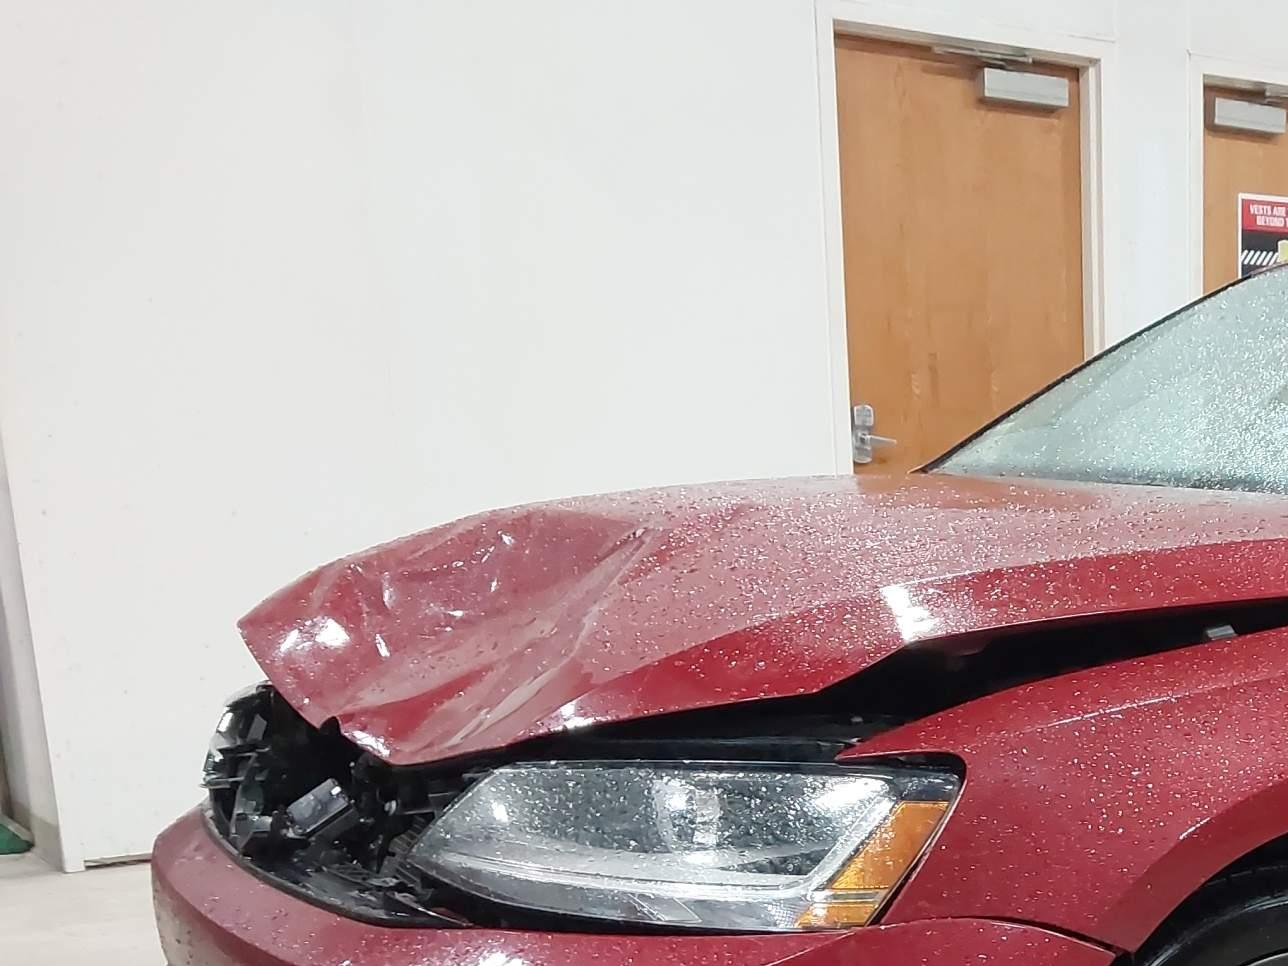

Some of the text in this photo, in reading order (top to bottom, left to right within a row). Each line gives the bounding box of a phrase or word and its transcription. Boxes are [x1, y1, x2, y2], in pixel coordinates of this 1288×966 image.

[1250, 204, 1271, 215] VESTS
[1273, 206, 1286, 217] ARE
[1256, 215, 1284, 226] BEYOND
